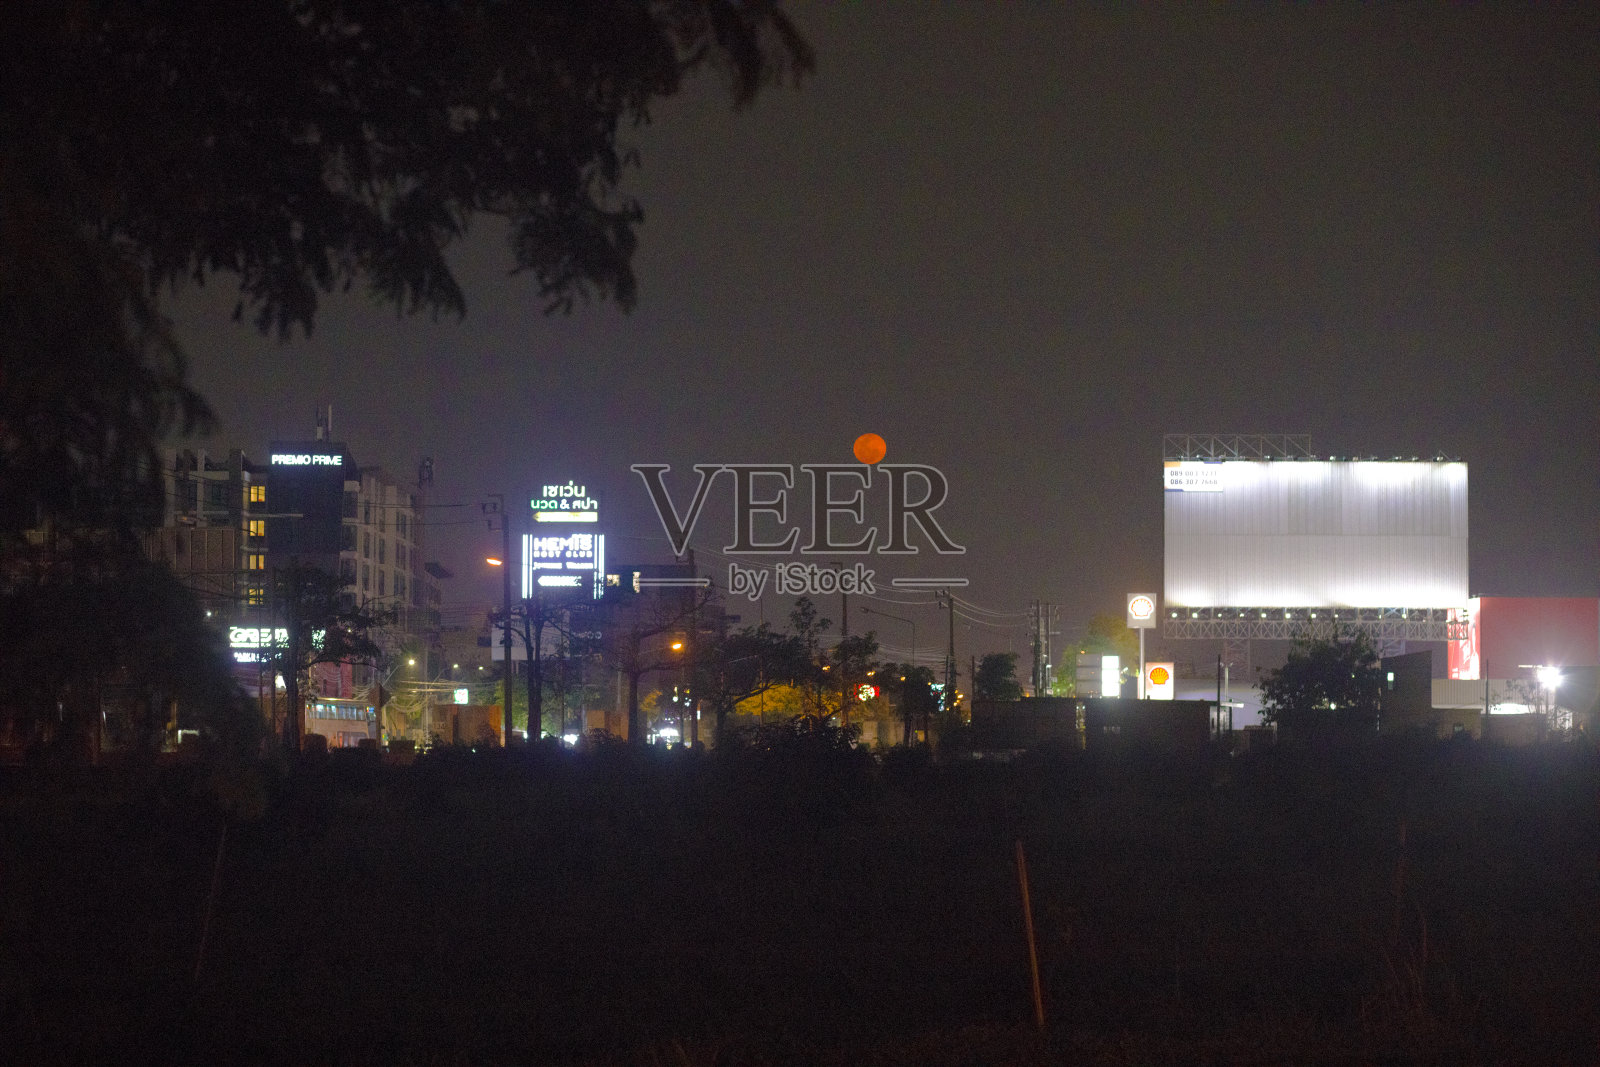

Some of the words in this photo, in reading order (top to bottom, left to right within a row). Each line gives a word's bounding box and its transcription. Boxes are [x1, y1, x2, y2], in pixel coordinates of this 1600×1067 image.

[271, 454, 312, 465] PREMIO
[312, 455, 343, 466] PRIME
[530, 499, 558, 509] นวด
[560, 498, 570, 509] &
[572, 497, 598, 509] สปา
